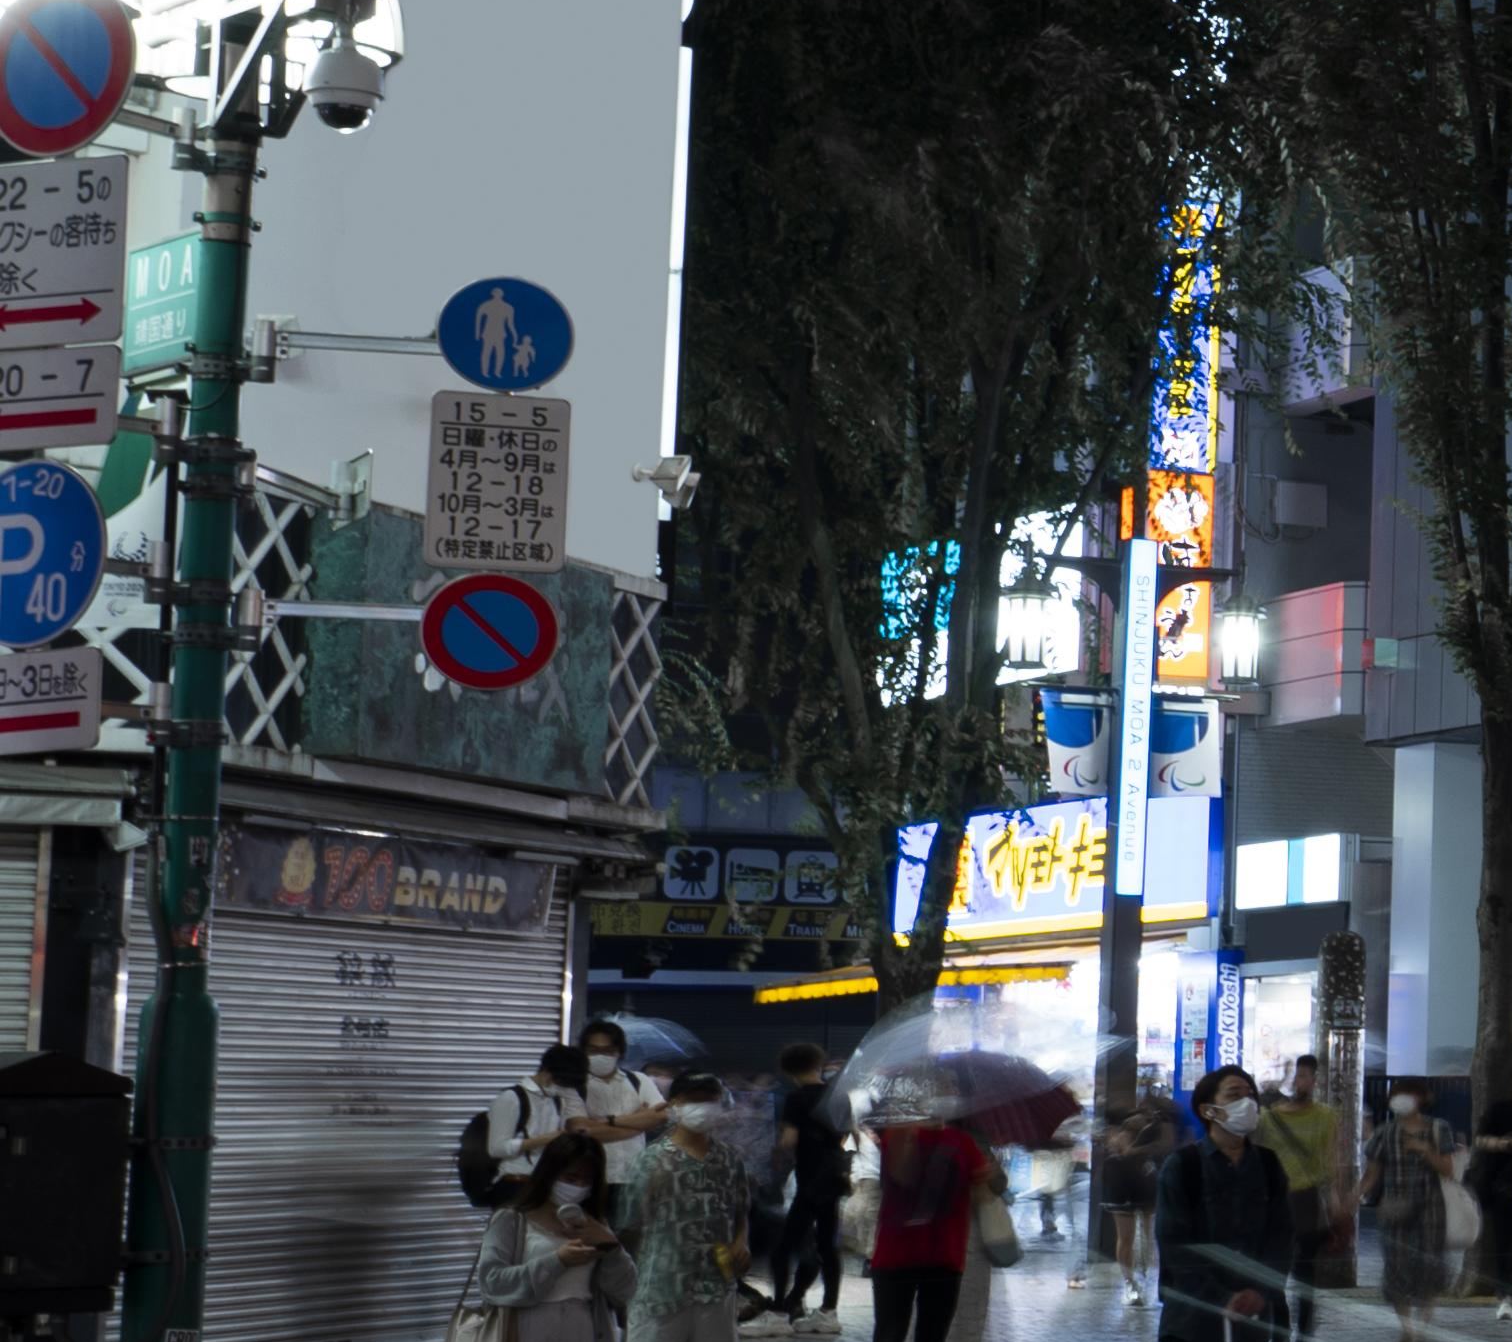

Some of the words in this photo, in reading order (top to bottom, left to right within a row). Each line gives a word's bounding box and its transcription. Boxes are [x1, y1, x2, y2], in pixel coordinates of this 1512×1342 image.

[135, 308, 188, 347] 靖国通り
[452, 401, 486, 423] 15
[533, 406, 548, 427] 5
[25, 572, 67, 624] 40
[1131, 574, 1150, 686] SHINJUKU
[1129, 699, 1145, 746] MOA
[1122, 783, 1141, 863] Avenue
[323, 845, 393, 911] 100
[393, 865, 508, 915] BRAND
[665, 920, 705, 935] CINEMA
